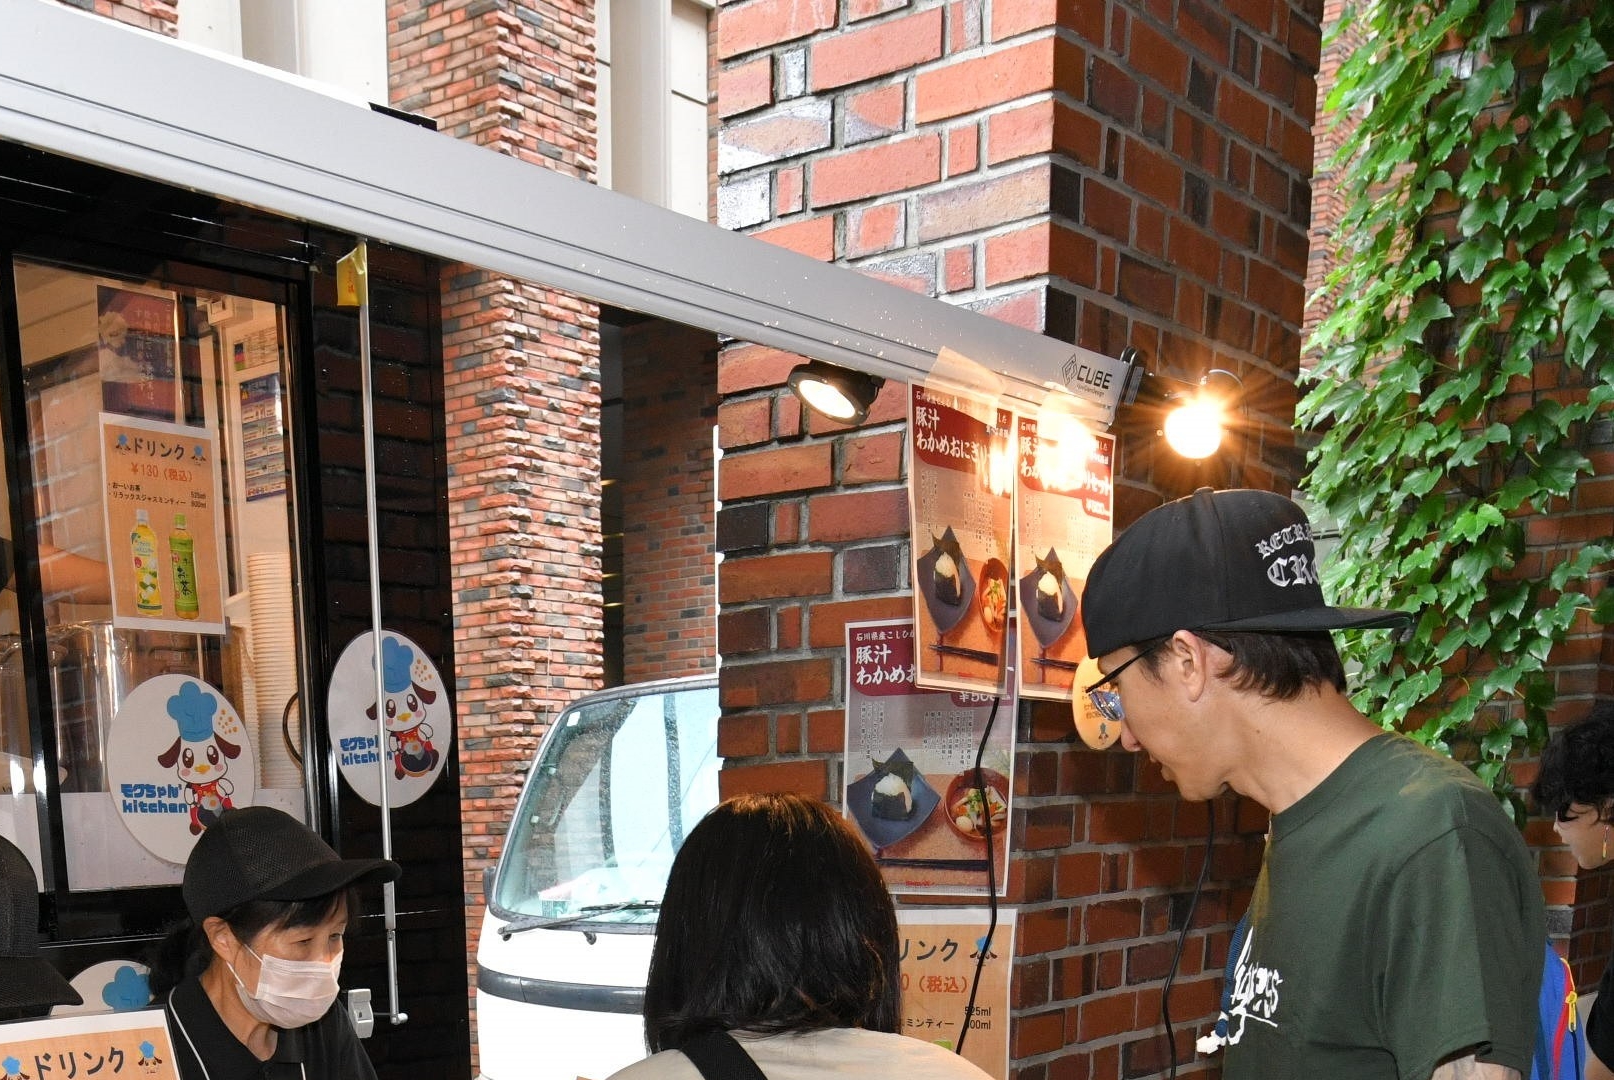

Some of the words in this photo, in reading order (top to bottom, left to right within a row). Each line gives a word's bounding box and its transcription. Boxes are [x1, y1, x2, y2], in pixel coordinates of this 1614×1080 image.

[1076, 364, 1114, 390] CUBE
[915, 406, 940, 431] 豚汁
[133, 438, 186, 460] ドリンク
[855, 643, 892, 665] 豚汁
[122, 800, 188, 814] kitchen
